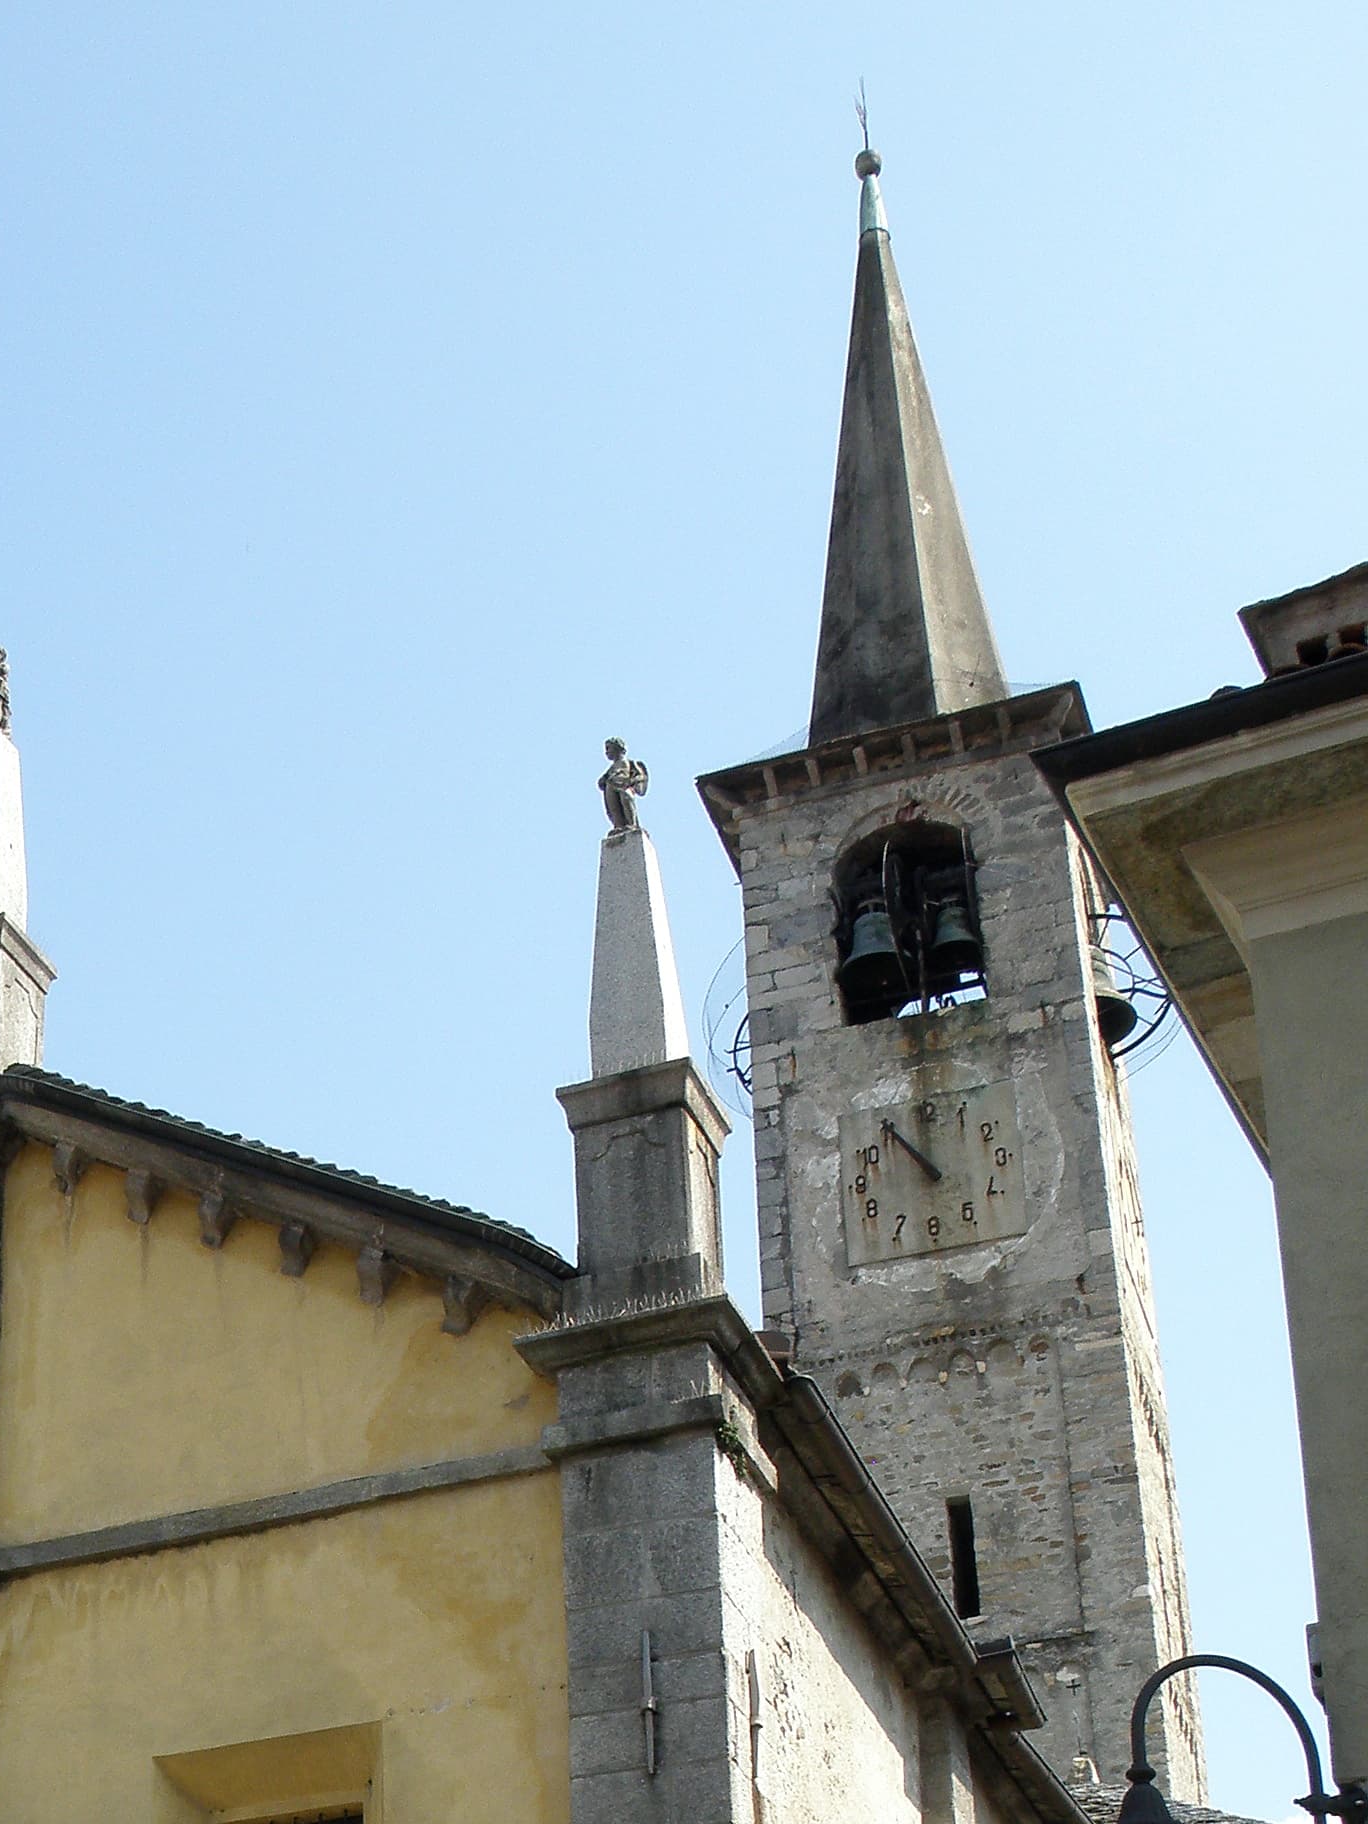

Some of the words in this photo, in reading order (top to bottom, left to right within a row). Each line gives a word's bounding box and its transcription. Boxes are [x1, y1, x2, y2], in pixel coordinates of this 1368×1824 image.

[981, 1122, 993, 1142] 2
[858, 1145, 879, 1170] 10
[855, 1175, 866, 1194] 9
[866, 1199, 878, 1218] 8
[962, 1201, 974, 1221] 5
[895, 1215, 906, 1236] 7
